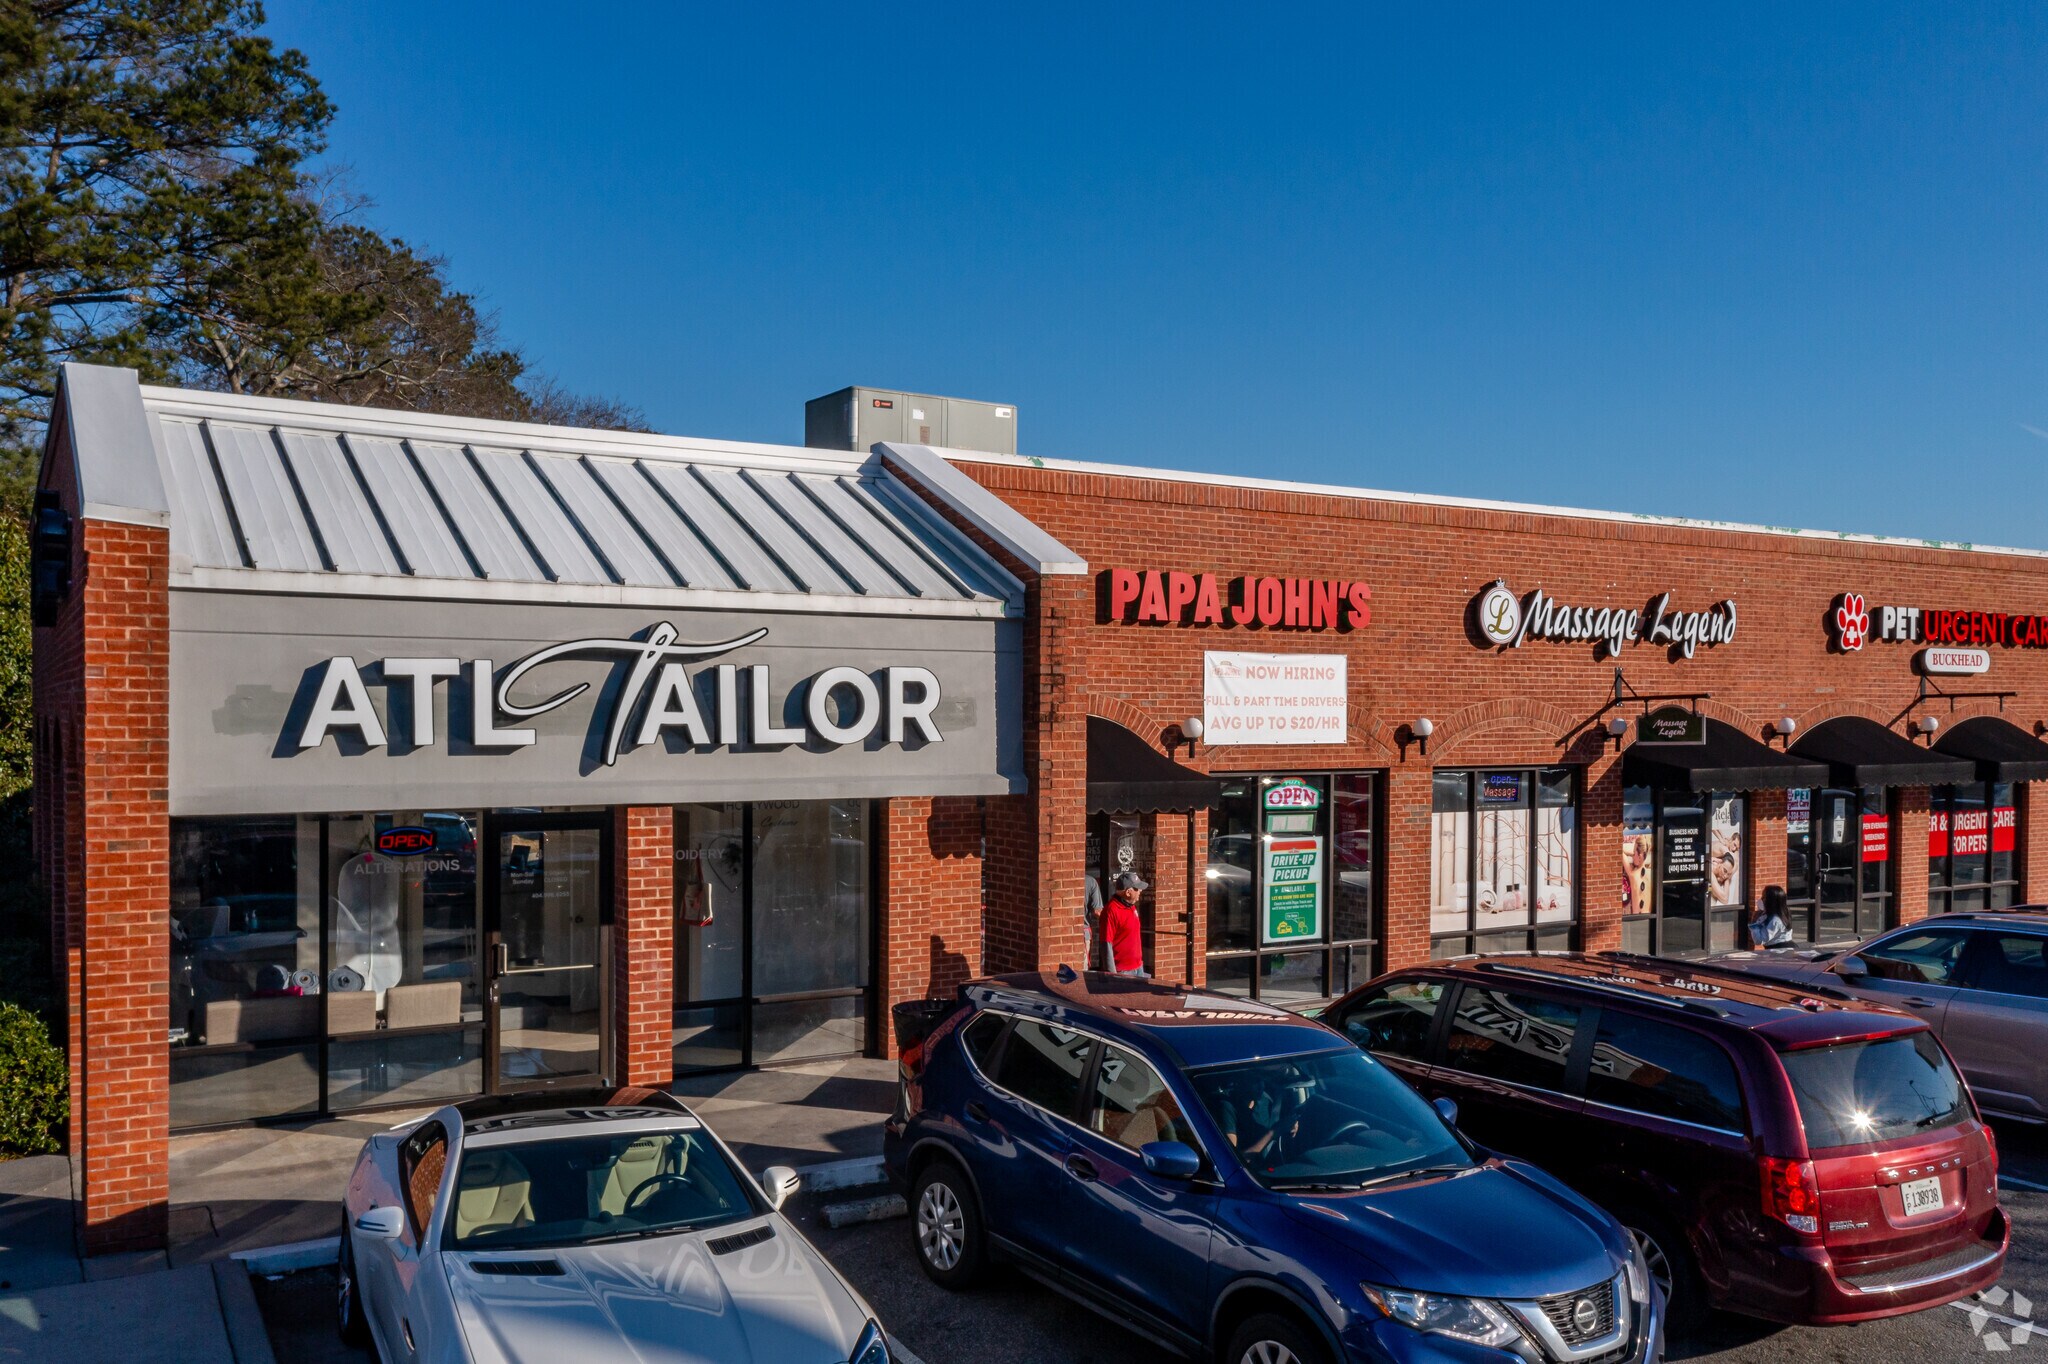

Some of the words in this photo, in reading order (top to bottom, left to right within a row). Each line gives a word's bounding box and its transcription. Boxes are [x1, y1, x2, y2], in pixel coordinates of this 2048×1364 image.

[1111, 569, 1223, 623] PAPA
[1232, 576, 1372, 629] JOHN'S
[1515, 589, 1638, 658] Massage
[1650, 592, 1737, 659] Legend
[1882, 606, 1920, 641] PET
[1924, 610, 2008, 643] URGENT
[2012, 615, 2048, 645] CAR
[1932, 653, 1983, 667] BUCKHEAD
[1246, 666, 1281, 680] NOW
[1284, 667, 1336, 680] HIRING
[298, 656, 537, 748] ATL
[498, 621, 944, 767] TAILOR
[1206, 696, 1231, 706] FULL
[1234, 696, 1241, 706] &
[1244, 696, 1272, 706] PART
[1273, 697, 1298, 706] TIME
[1301, 697, 1345, 706] DRIVERS
[1210, 716, 1242, 730] AVG
[1246, 717, 1265, 730] UP
[1268, 717, 1287, 730] TO
[1290, 716, 1340, 730] $20/HR
[1652, 719, 1688, 729] Massage
[1658, 728, 1686, 738] Legend
[1268, 787, 1316, 805] OPEN
[1794, 790, 1809, 800] PET
[1940, 814, 1948, 832] &
[1993, 811, 2015, 828] CARE
[380, 834, 434, 849] OPEN
[1968, 834, 1988, 852] PETS
[675, 848, 725, 860] OIDERY
[1273, 854, 1315, 866] DRIVE-UP
[353, 859, 460, 875] ALTERATIONS
[1275, 868, 1308, 880] PICKUP
[1912, 1187, 1940, 1208] 138938
[1577, 1312, 1597, 1322] NISSAN
